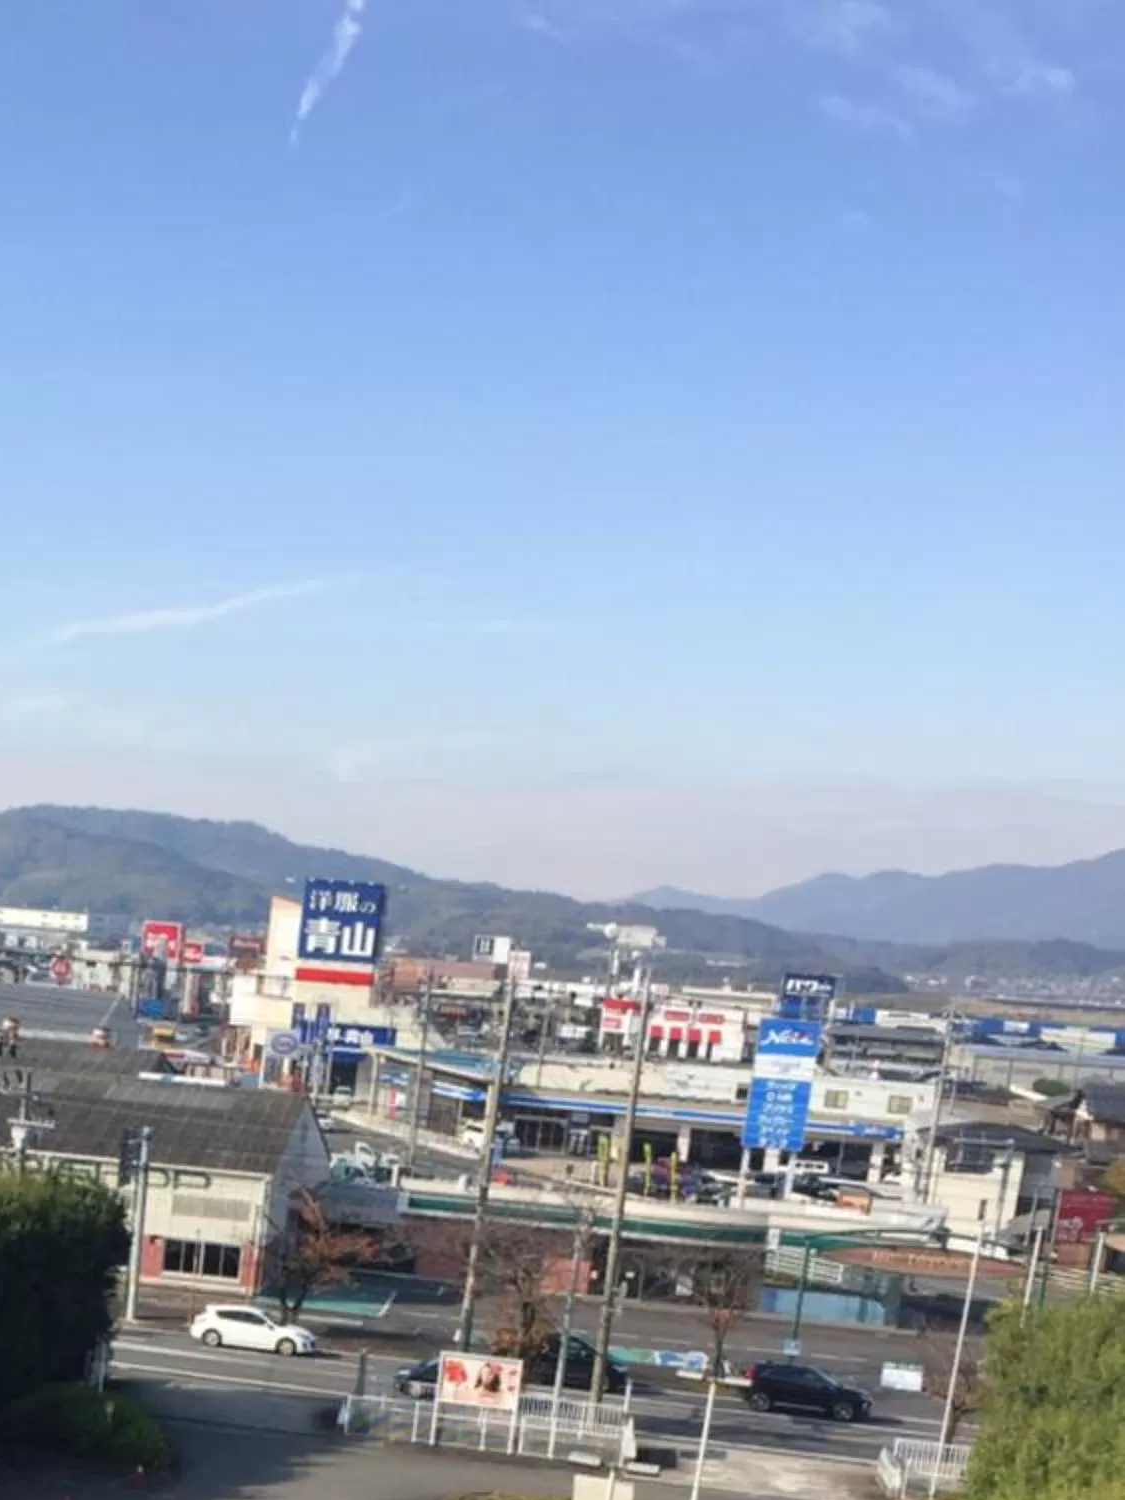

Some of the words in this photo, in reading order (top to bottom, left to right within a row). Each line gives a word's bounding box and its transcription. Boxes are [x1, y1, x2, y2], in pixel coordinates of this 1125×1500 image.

[309, 889, 376, 913] 洋服の
[304, 916, 376, 957] 青山
